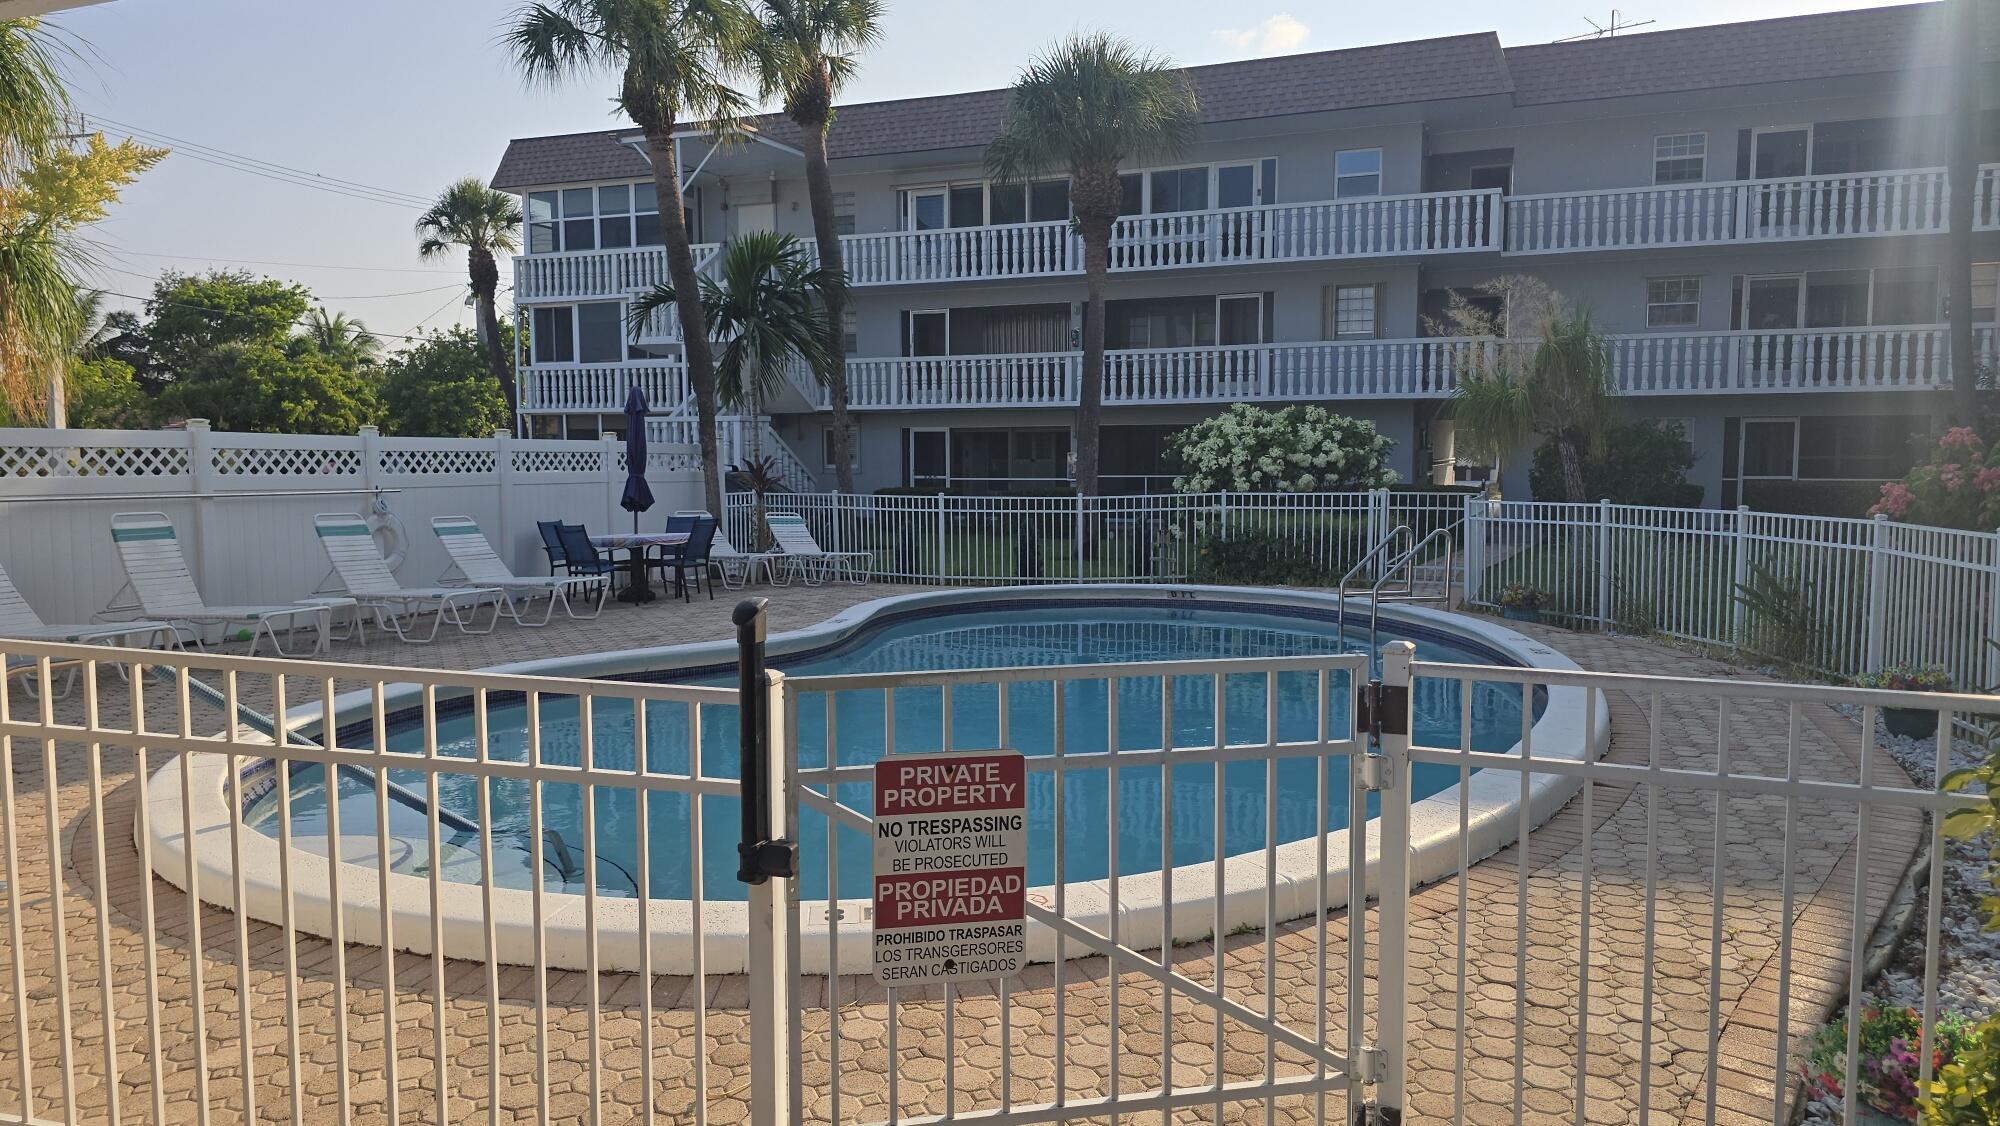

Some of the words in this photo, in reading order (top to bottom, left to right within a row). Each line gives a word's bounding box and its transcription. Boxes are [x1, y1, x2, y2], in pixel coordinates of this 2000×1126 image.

[900, 762, 1000, 786] PRIVATE
[884, 783, 1016, 808] PROPERTY
[878, 822, 902, 838] NO
[908, 815, 1022, 836] TRESPASSING
[895, 836, 970, 853] VIOLATORS
[975, 834, 1006, 848] WILL
[893, 858, 910, 872] BE
[915, 852, 1008, 870] PROSECUTED
[878, 875, 1021, 902] PROPIEDAD
[898, 896, 1004, 920] PRIVADA
[876, 930, 945, 946] PROHIBIDO
[949, 924, 1022, 941] TRASPASAR
[876, 948, 902, 963] LOS
[906, 940, 1023, 960] TRANSGERSORES
[882, 965, 928, 980] SERAN
[932, 958, 1016, 977] CASTIGADOS
